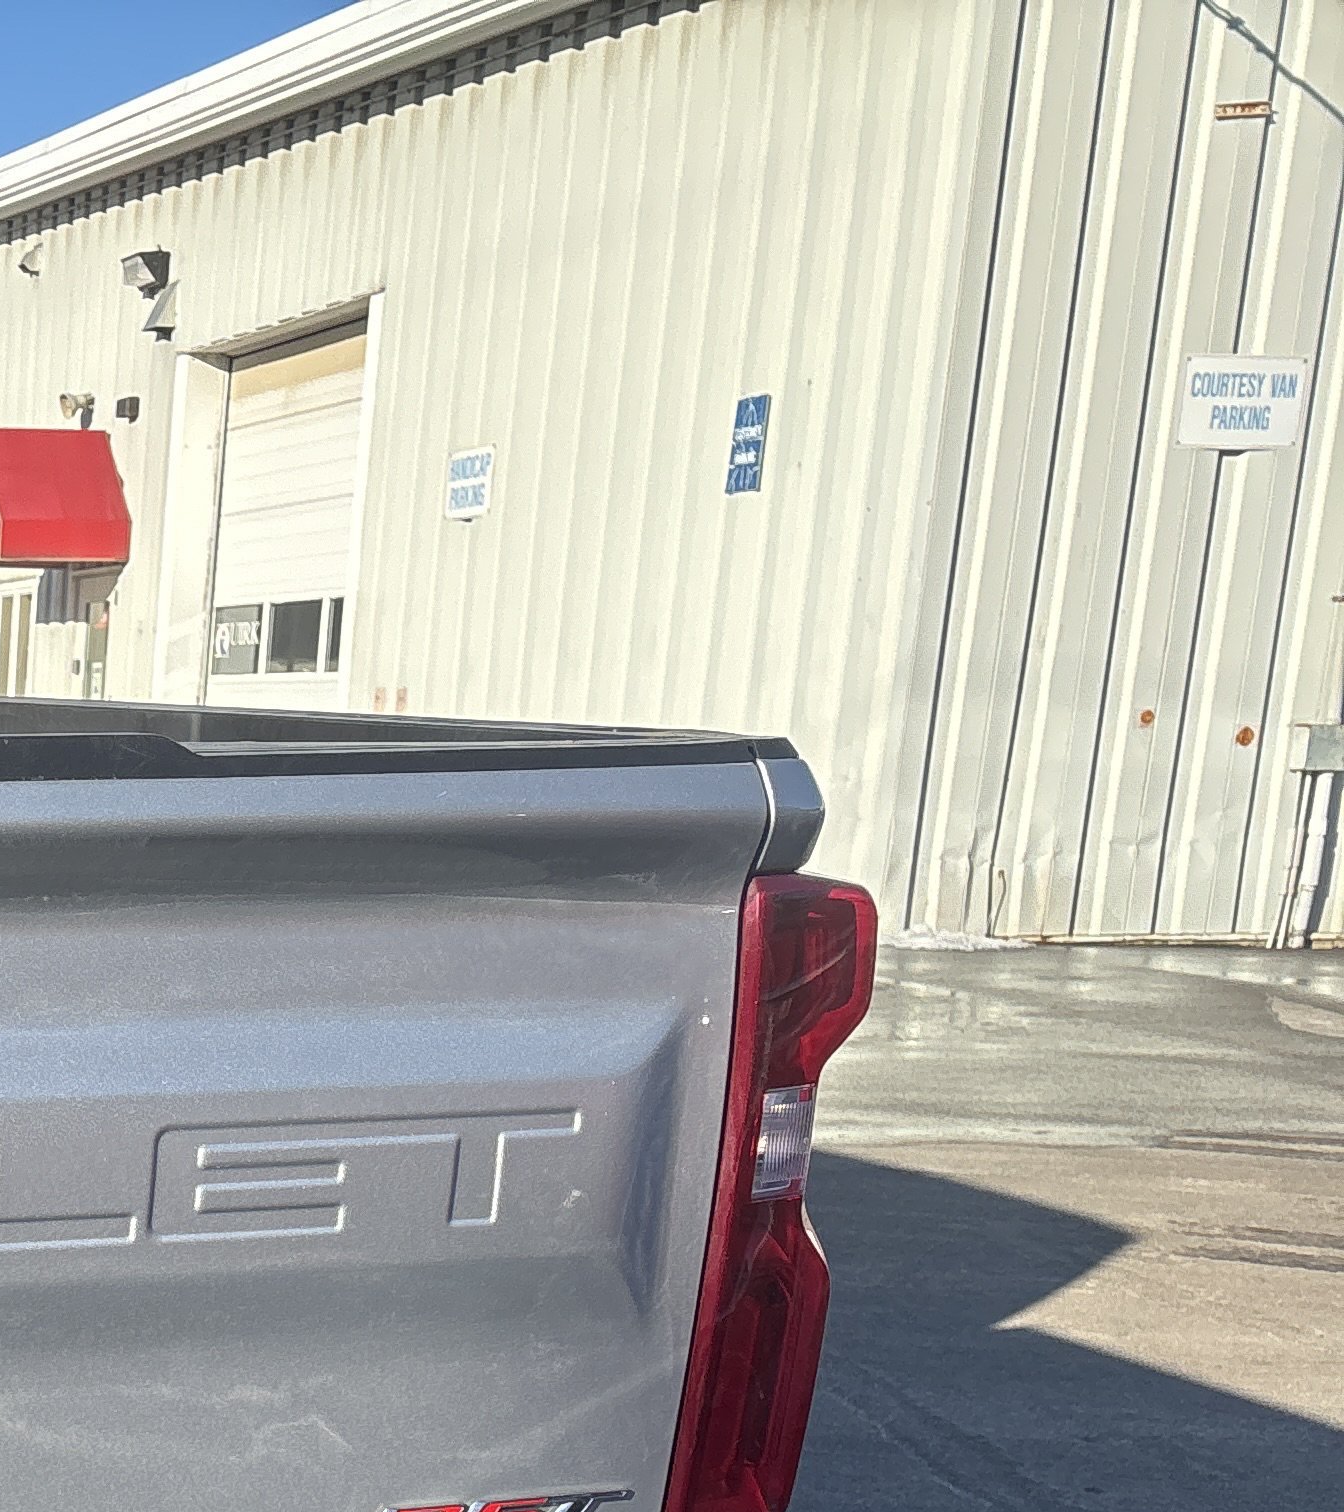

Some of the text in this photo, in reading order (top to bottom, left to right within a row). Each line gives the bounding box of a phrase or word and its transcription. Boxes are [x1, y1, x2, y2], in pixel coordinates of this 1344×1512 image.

[1191, 371, 1299, 399] COURTESY VAN
[1209, 404, 1272, 430] PARKING
